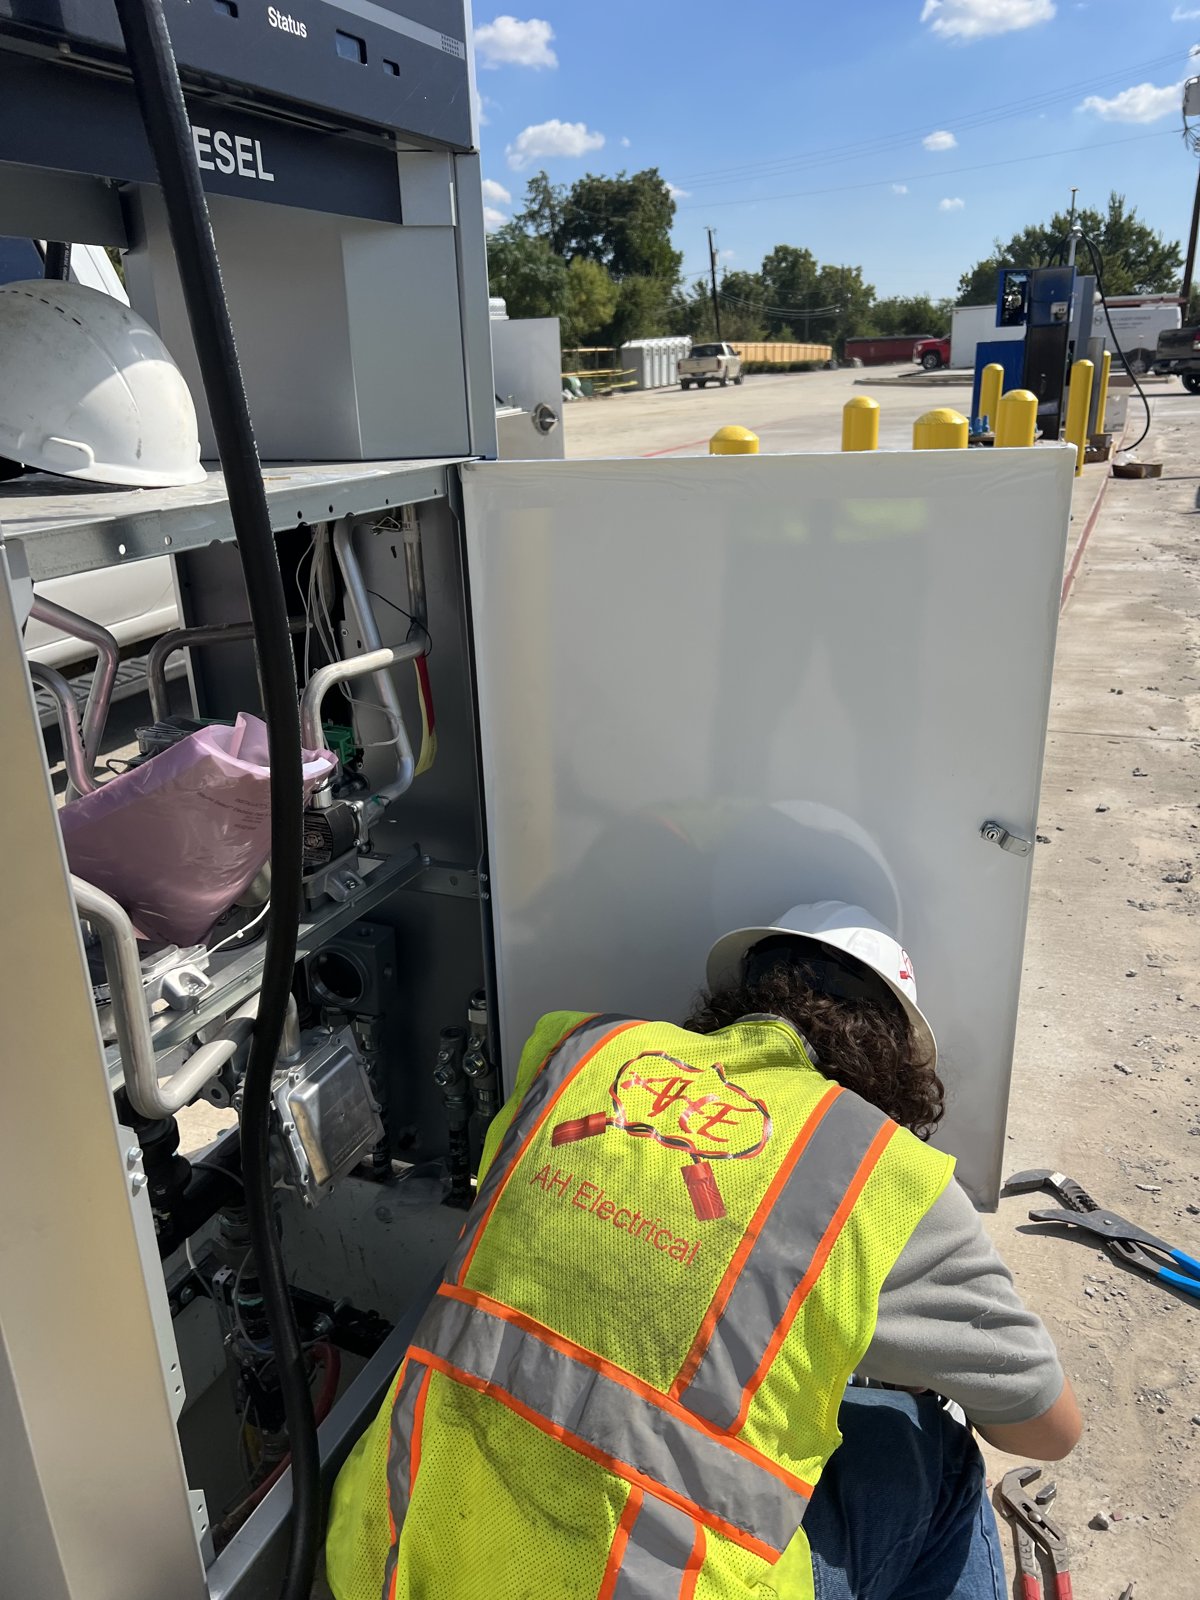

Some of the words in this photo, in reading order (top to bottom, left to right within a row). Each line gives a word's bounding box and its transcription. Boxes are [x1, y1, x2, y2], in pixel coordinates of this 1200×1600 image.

[267, 6, 308, 39] Status
[192, 125, 275, 182] ESEL
[529, 1163, 574, 1198] AH
[571, 1180, 702, 1266] Electrical
